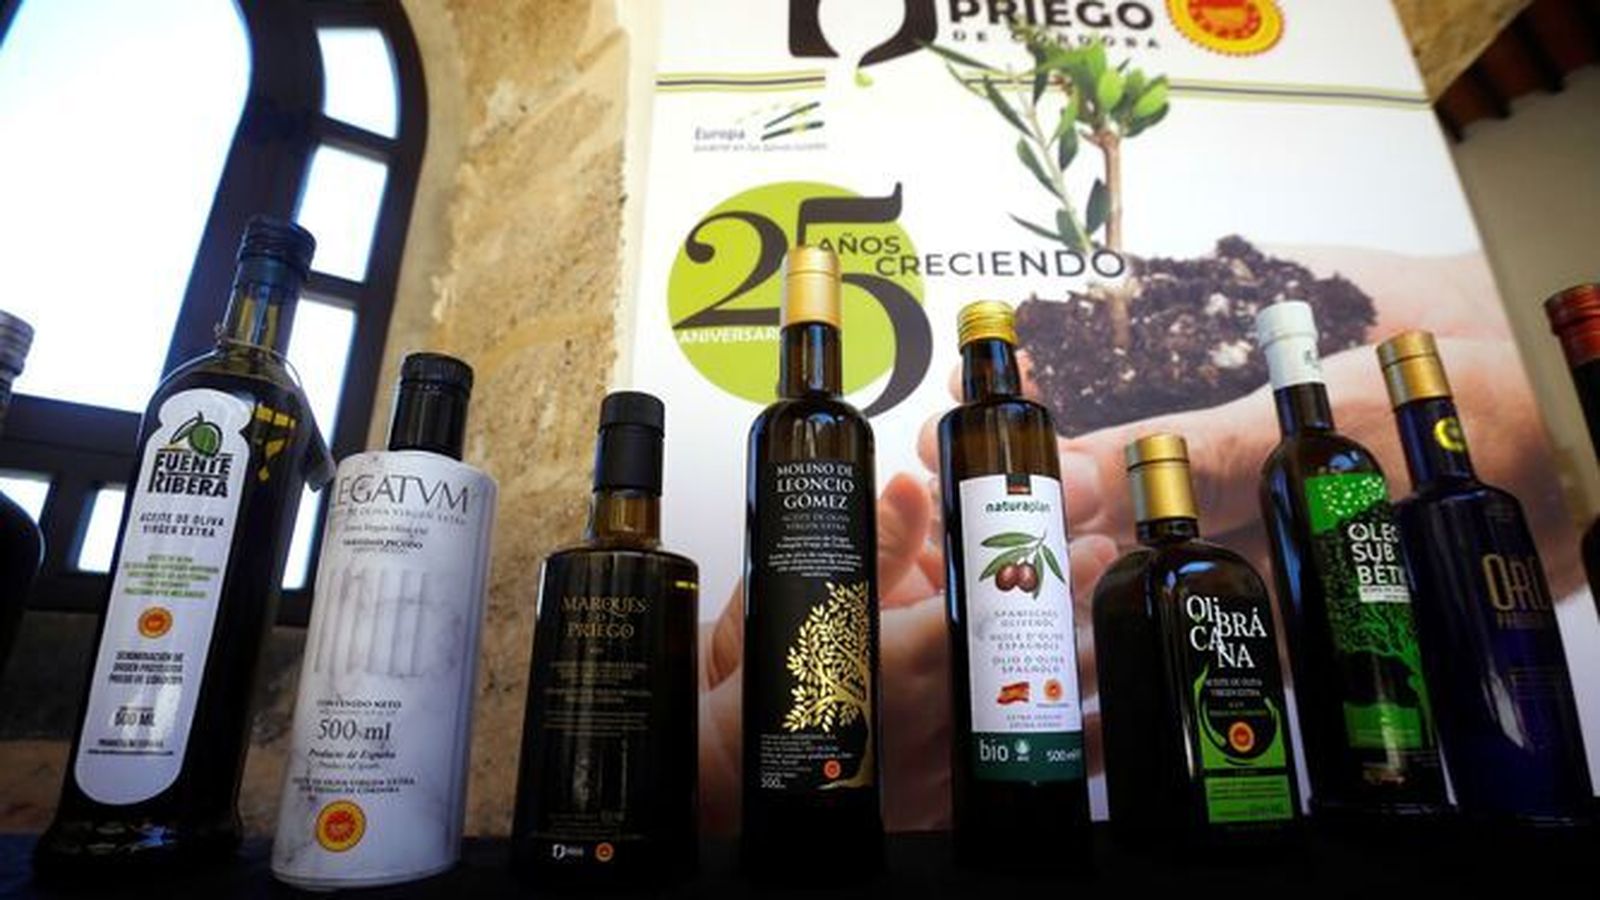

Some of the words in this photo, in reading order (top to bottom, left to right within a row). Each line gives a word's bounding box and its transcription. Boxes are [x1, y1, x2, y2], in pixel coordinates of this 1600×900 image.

[950, 0, 1154, 30] PRIEGO
[694, 126, 746, 142] Europa
[819, 231, 901, 255] AÑOS
[875, 249, 1126, 280] CRECIENDO
[672, 182, 934, 419] 25
[679, 325, 780, 344] ANIVERSAR
[154, 453, 233, 476] FUENTE
[776, 462, 835, 477] MOLINO
[836, 464, 853, 477] DE
[147, 474, 231, 499] RIBERA
[776, 476, 855, 493] LEONCIO
[783, 492, 849, 510] GÓMEZ
[985, 501, 1051, 514] naturaplan
[139, 511, 174, 524] ACEITE
[175, 513, 190, 524] DE
[192, 515, 225, 528] OLIVA
[142, 525, 178, 536] VIRGEN
[180, 526, 216, 538] EXTRA
[1351, 542, 1396, 562] SUB
[566, 621, 636, 640] PRIEGO
[114, 711, 137, 727] 500
[316, 718, 358, 741] 500
[364, 721, 392, 741] ml
[979, 738, 1010, 762] bio
